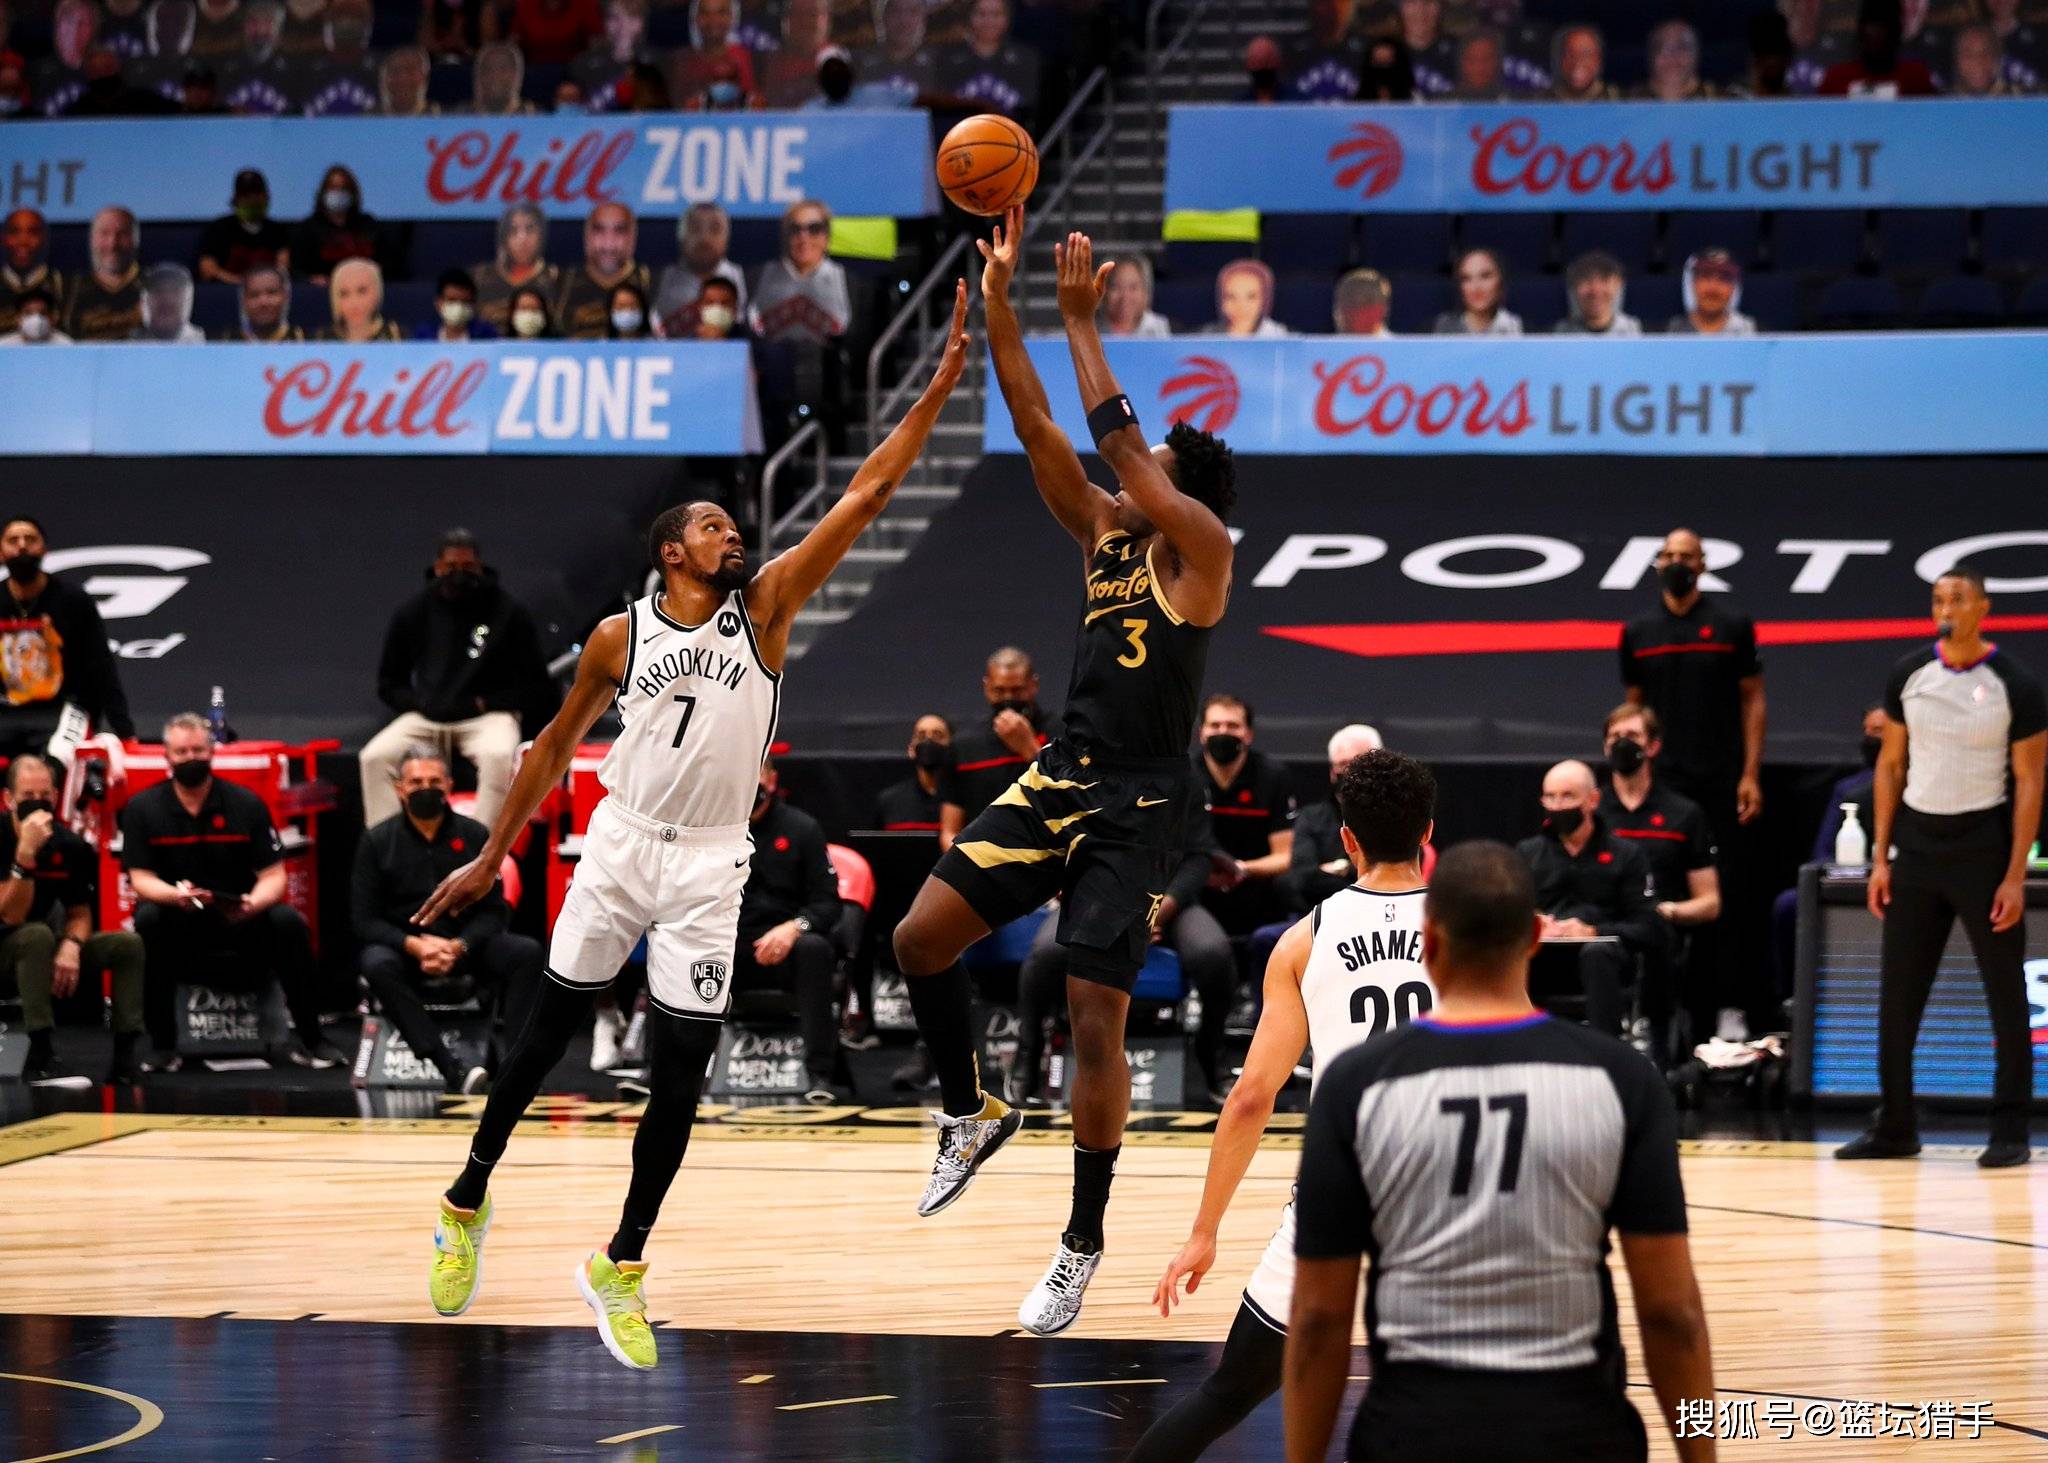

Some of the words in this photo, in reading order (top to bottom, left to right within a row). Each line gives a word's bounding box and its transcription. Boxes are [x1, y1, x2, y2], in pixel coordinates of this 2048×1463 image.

[426, 129, 636, 203] Chill
[642, 126, 808, 202] ZONE
[1469, 117, 1678, 195] Coors
[1689, 140, 1882, 193] LIGHT
[0, 161, 85, 205] HT
[263, 358, 490, 438] Chill
[496, 356, 673, 440] ZONE
[1312, 353, 1535, 438] Coors
[1549, 382, 1756, 436] LIGHT
[1229, 527, 2048, 594] PORT
[1116, 618, 1148, 669] 3
[636, 647, 748, 698] BROOKLYN
[671, 694, 697, 749] 7
[693, 962, 727, 981] NETS
[1336, 930, 1424, 972] SHAME
[727, 1059, 778, 1075] MEN
[730, 1030, 805, 1057] Dove
[1439, 1092, 1528, 1198] 77
